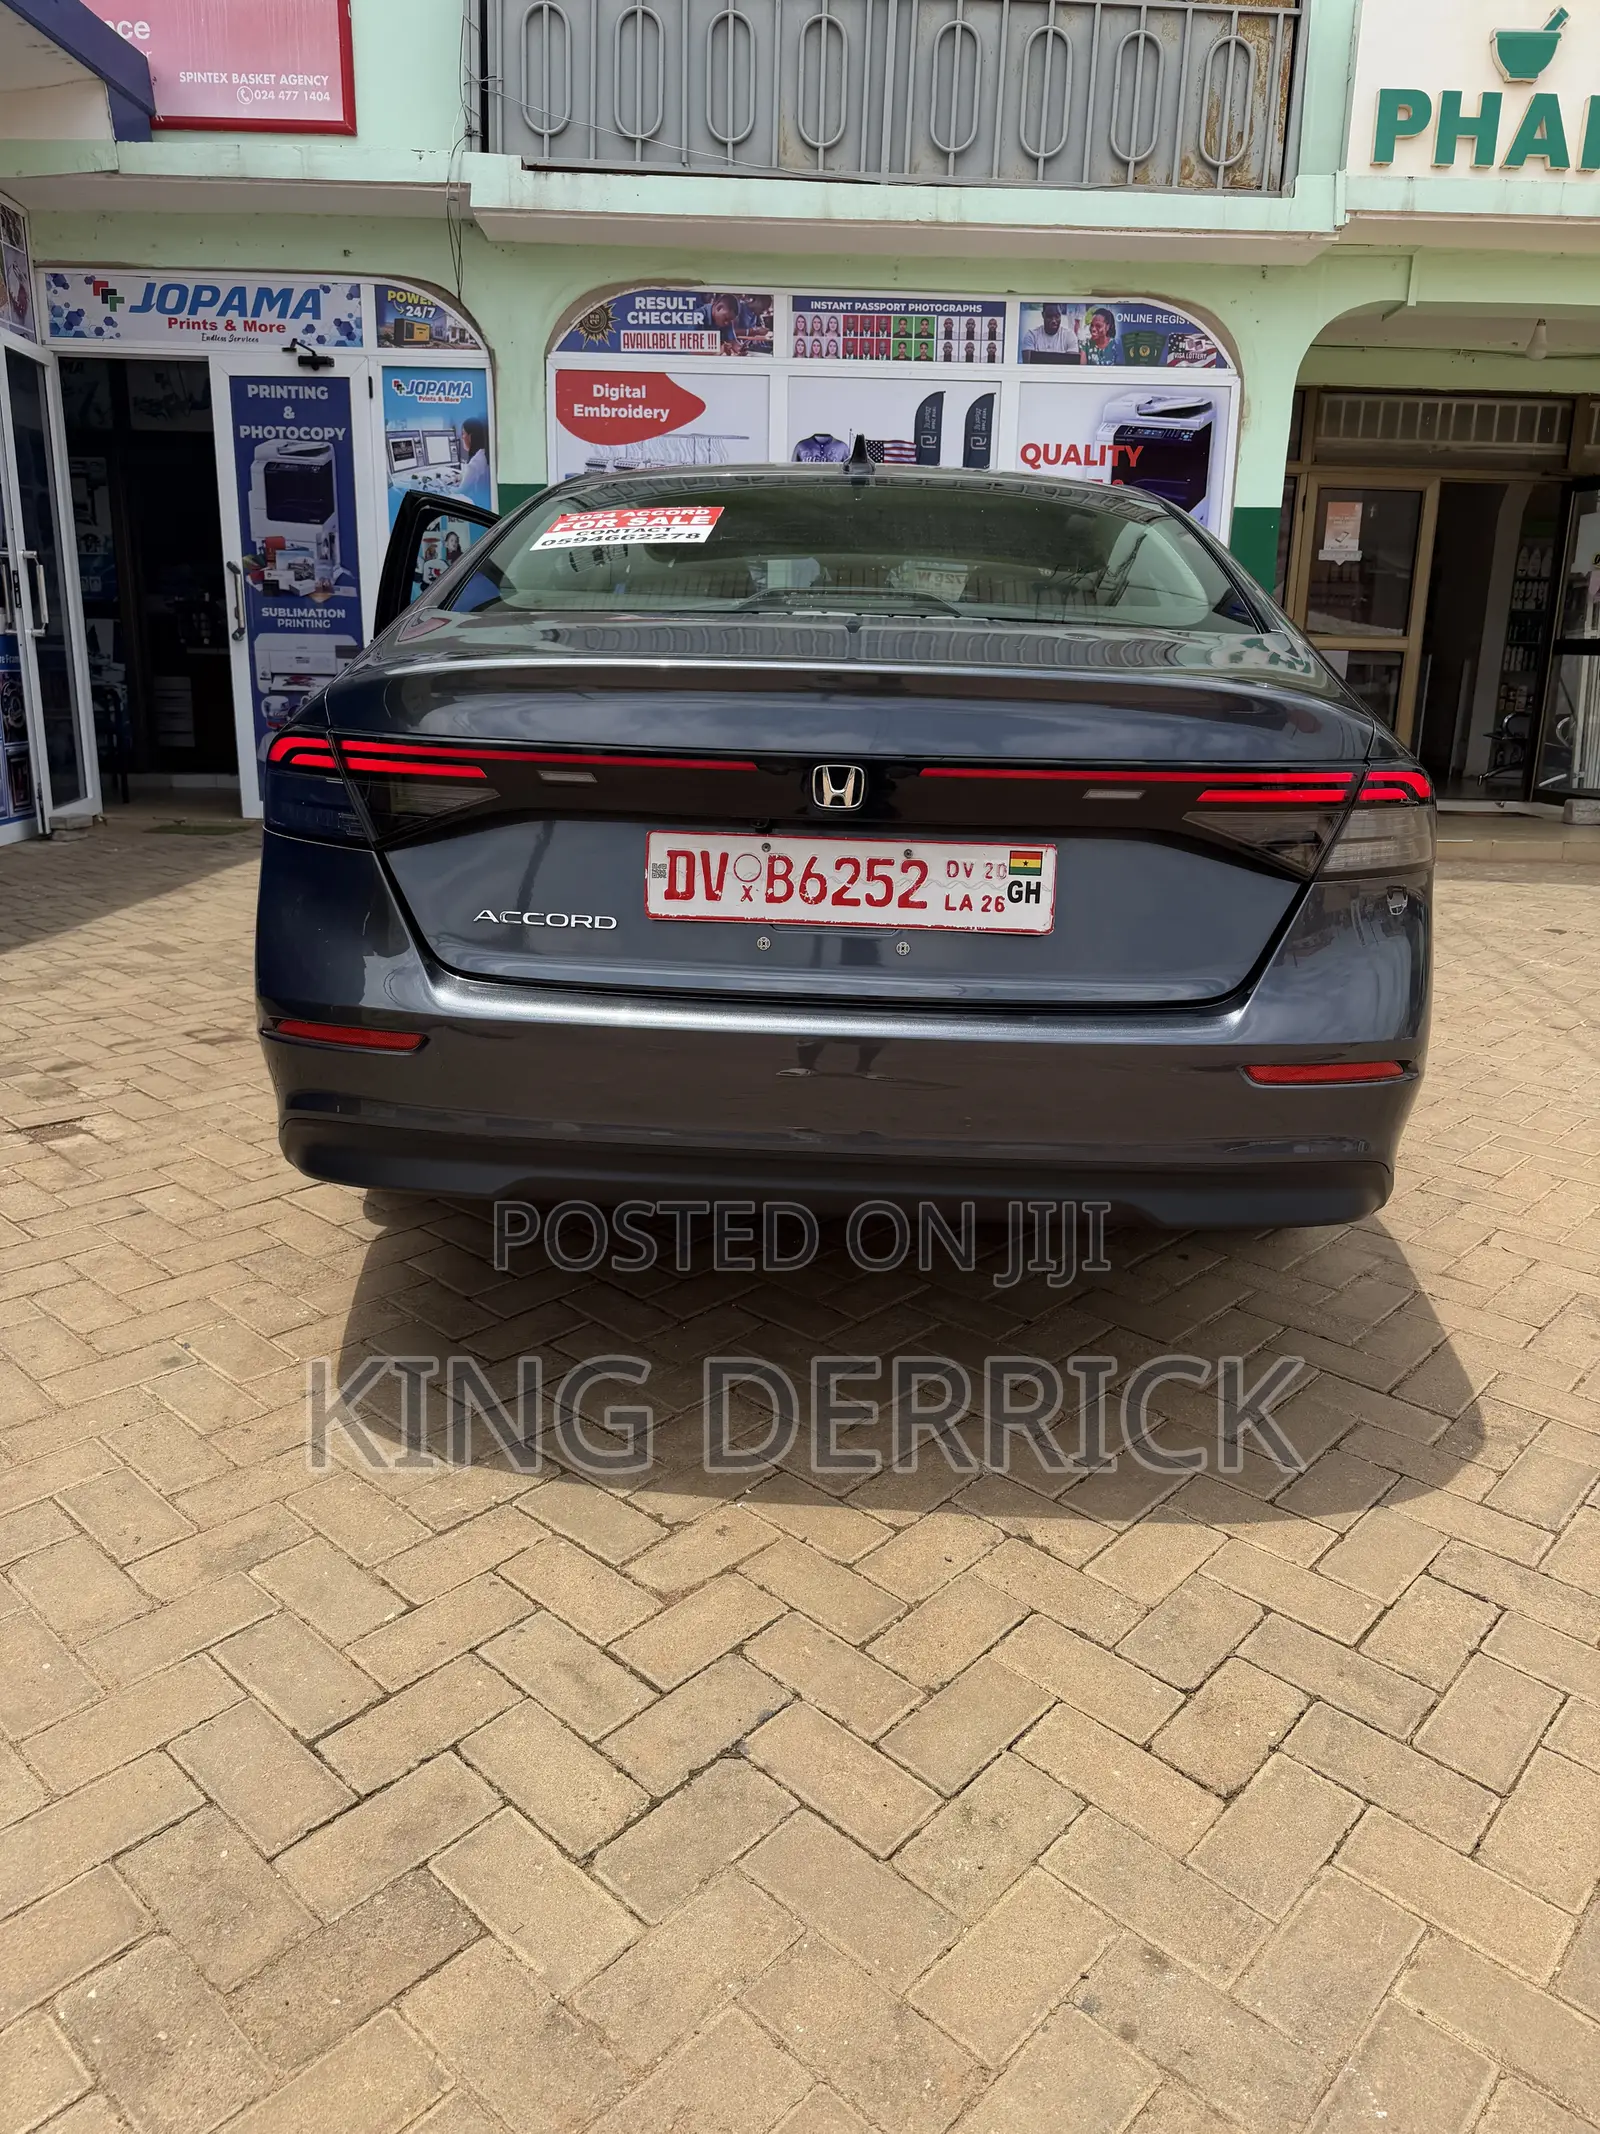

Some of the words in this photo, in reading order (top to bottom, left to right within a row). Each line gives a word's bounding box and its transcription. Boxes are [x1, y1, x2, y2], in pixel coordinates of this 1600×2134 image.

[106, 20, 151, 40] ce
[179, 72, 229, 84] SPINTEX
[232, 73, 276, 85] BASKET
[279, 74, 329, 86] AGENCY
[254, 91, 275, 101] 024
[278, 91, 299, 101] 477
[302, 91, 331, 101] 1404
[129, 282, 322, 320] JOPAMA
[635, 296, 697, 310] RESULT
[810, 301, 852, 311] INSTANT
[854, 302, 906, 312] PASSPORT
[908, 303, 983, 313] PHOTOGRAPHS
[405, 305, 436, 319] 24/7
[626, 311, 705, 326] CHECKER
[1116, 313, 1153, 324] ONLINE
[1155, 314, 1190, 325] REGIS
[167, 317, 218, 331] Prints
[224, 319, 236, 332] &
[242, 319, 287, 333] More
[622, 332, 677, 350] AVAILABLE
[679, 334, 704, 350] HERE
[707, 335, 718, 350] !!!
[247, 384, 329, 400] PRINTING
[406, 379, 474, 398] JOPAMA
[593, 384, 647, 401] Digital
[283, 405, 296, 419] &
[573, 403, 670, 422] Embroidery
[239, 425, 347, 441] PHOTOCOPY
[1020, 443, 1144, 470] QUALITY
[568, 512, 617, 522] 2024
[621, 508, 711, 518] ACCORD
[552, 517, 619, 533] FOR
[627, 515, 712, 527] SALE
[576, 526, 676, 537] CONTACT
[541, 532, 701, 547] 0594662278
[261, 607, 346, 619] SUBLIMATION
[277, 618, 332, 630] PRINTING
[664, 849, 729, 902] DV
[946, 860, 974, 878] DV
[984, 862, 1008, 880] 20
[765, 853, 929, 909] B6252
[1007, 880, 1042, 904] GH
[944, 894, 973, 911] LA
[981, 895, 1006, 912] 26
[473, 909, 618, 930] ACCORD
